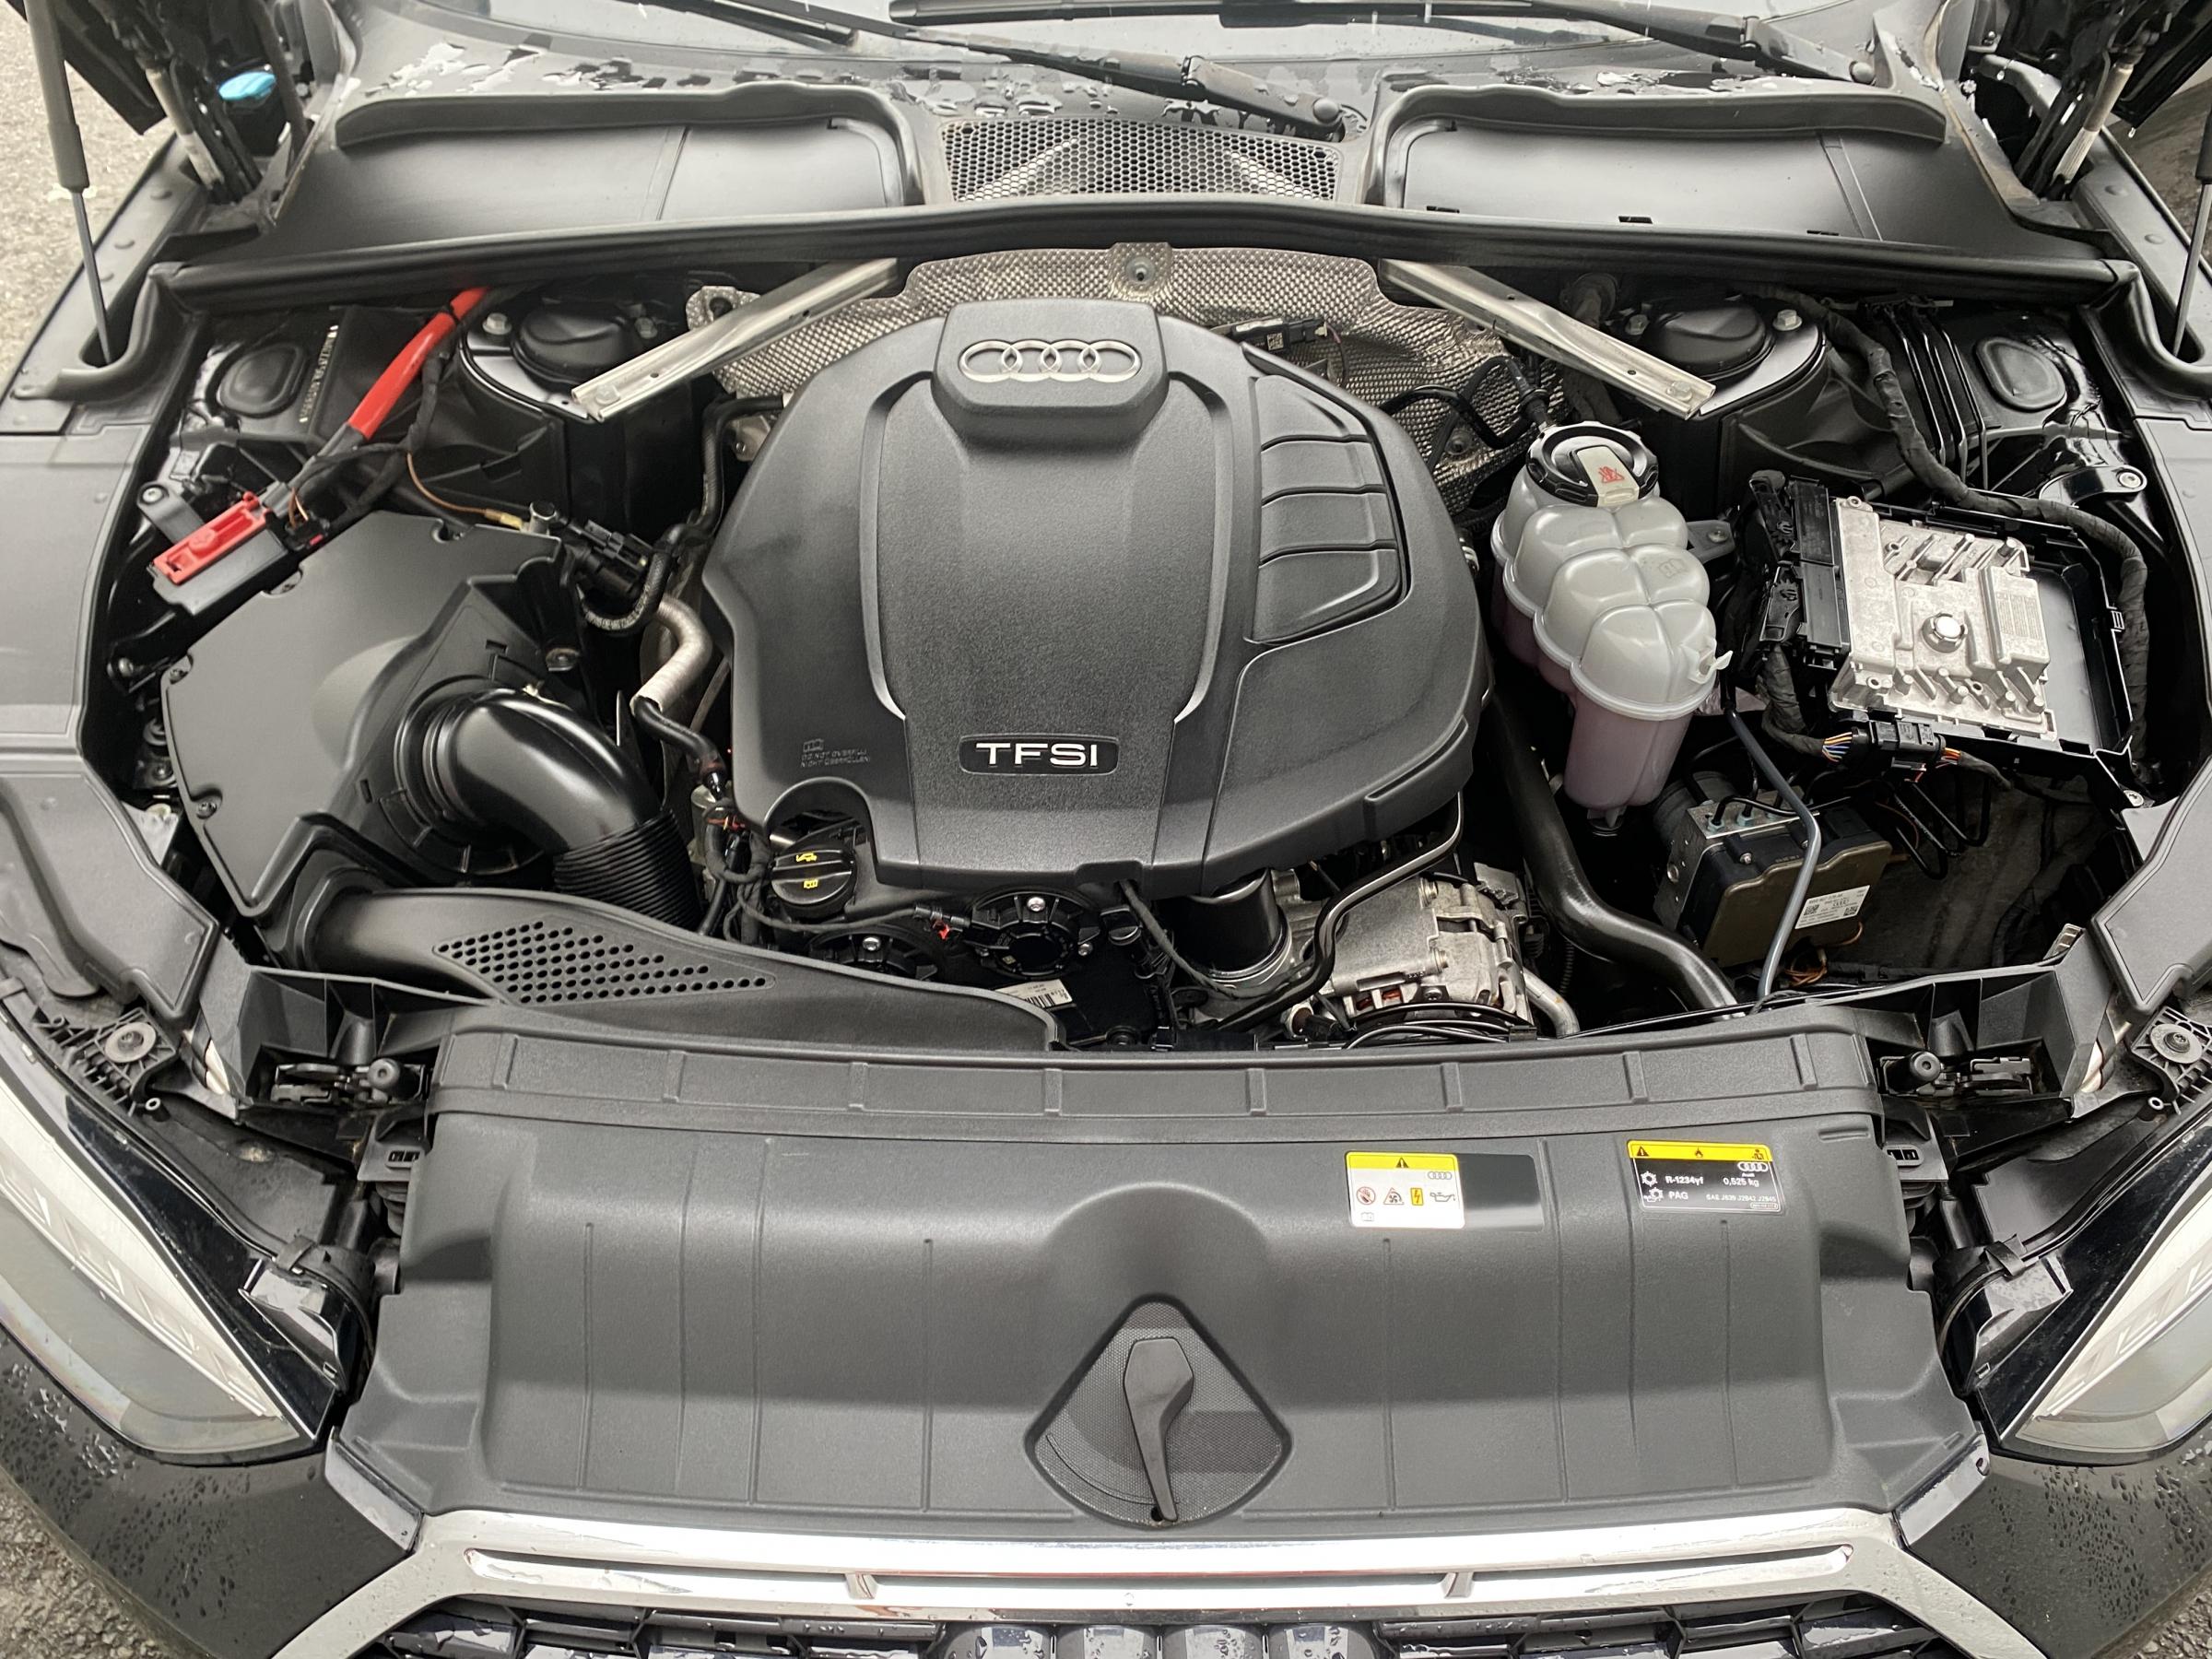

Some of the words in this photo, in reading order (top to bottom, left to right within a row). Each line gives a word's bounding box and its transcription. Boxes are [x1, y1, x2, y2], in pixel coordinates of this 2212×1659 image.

[976, 742, 1098, 767] TFSI
[1665, 1176, 1704, 1186] R-1234yf
[1723, 1177, 1747, 1186] 0,525
[1748, 1178, 1760, 1188] kg
[1668, 1191, 1688, 1200] PAG
